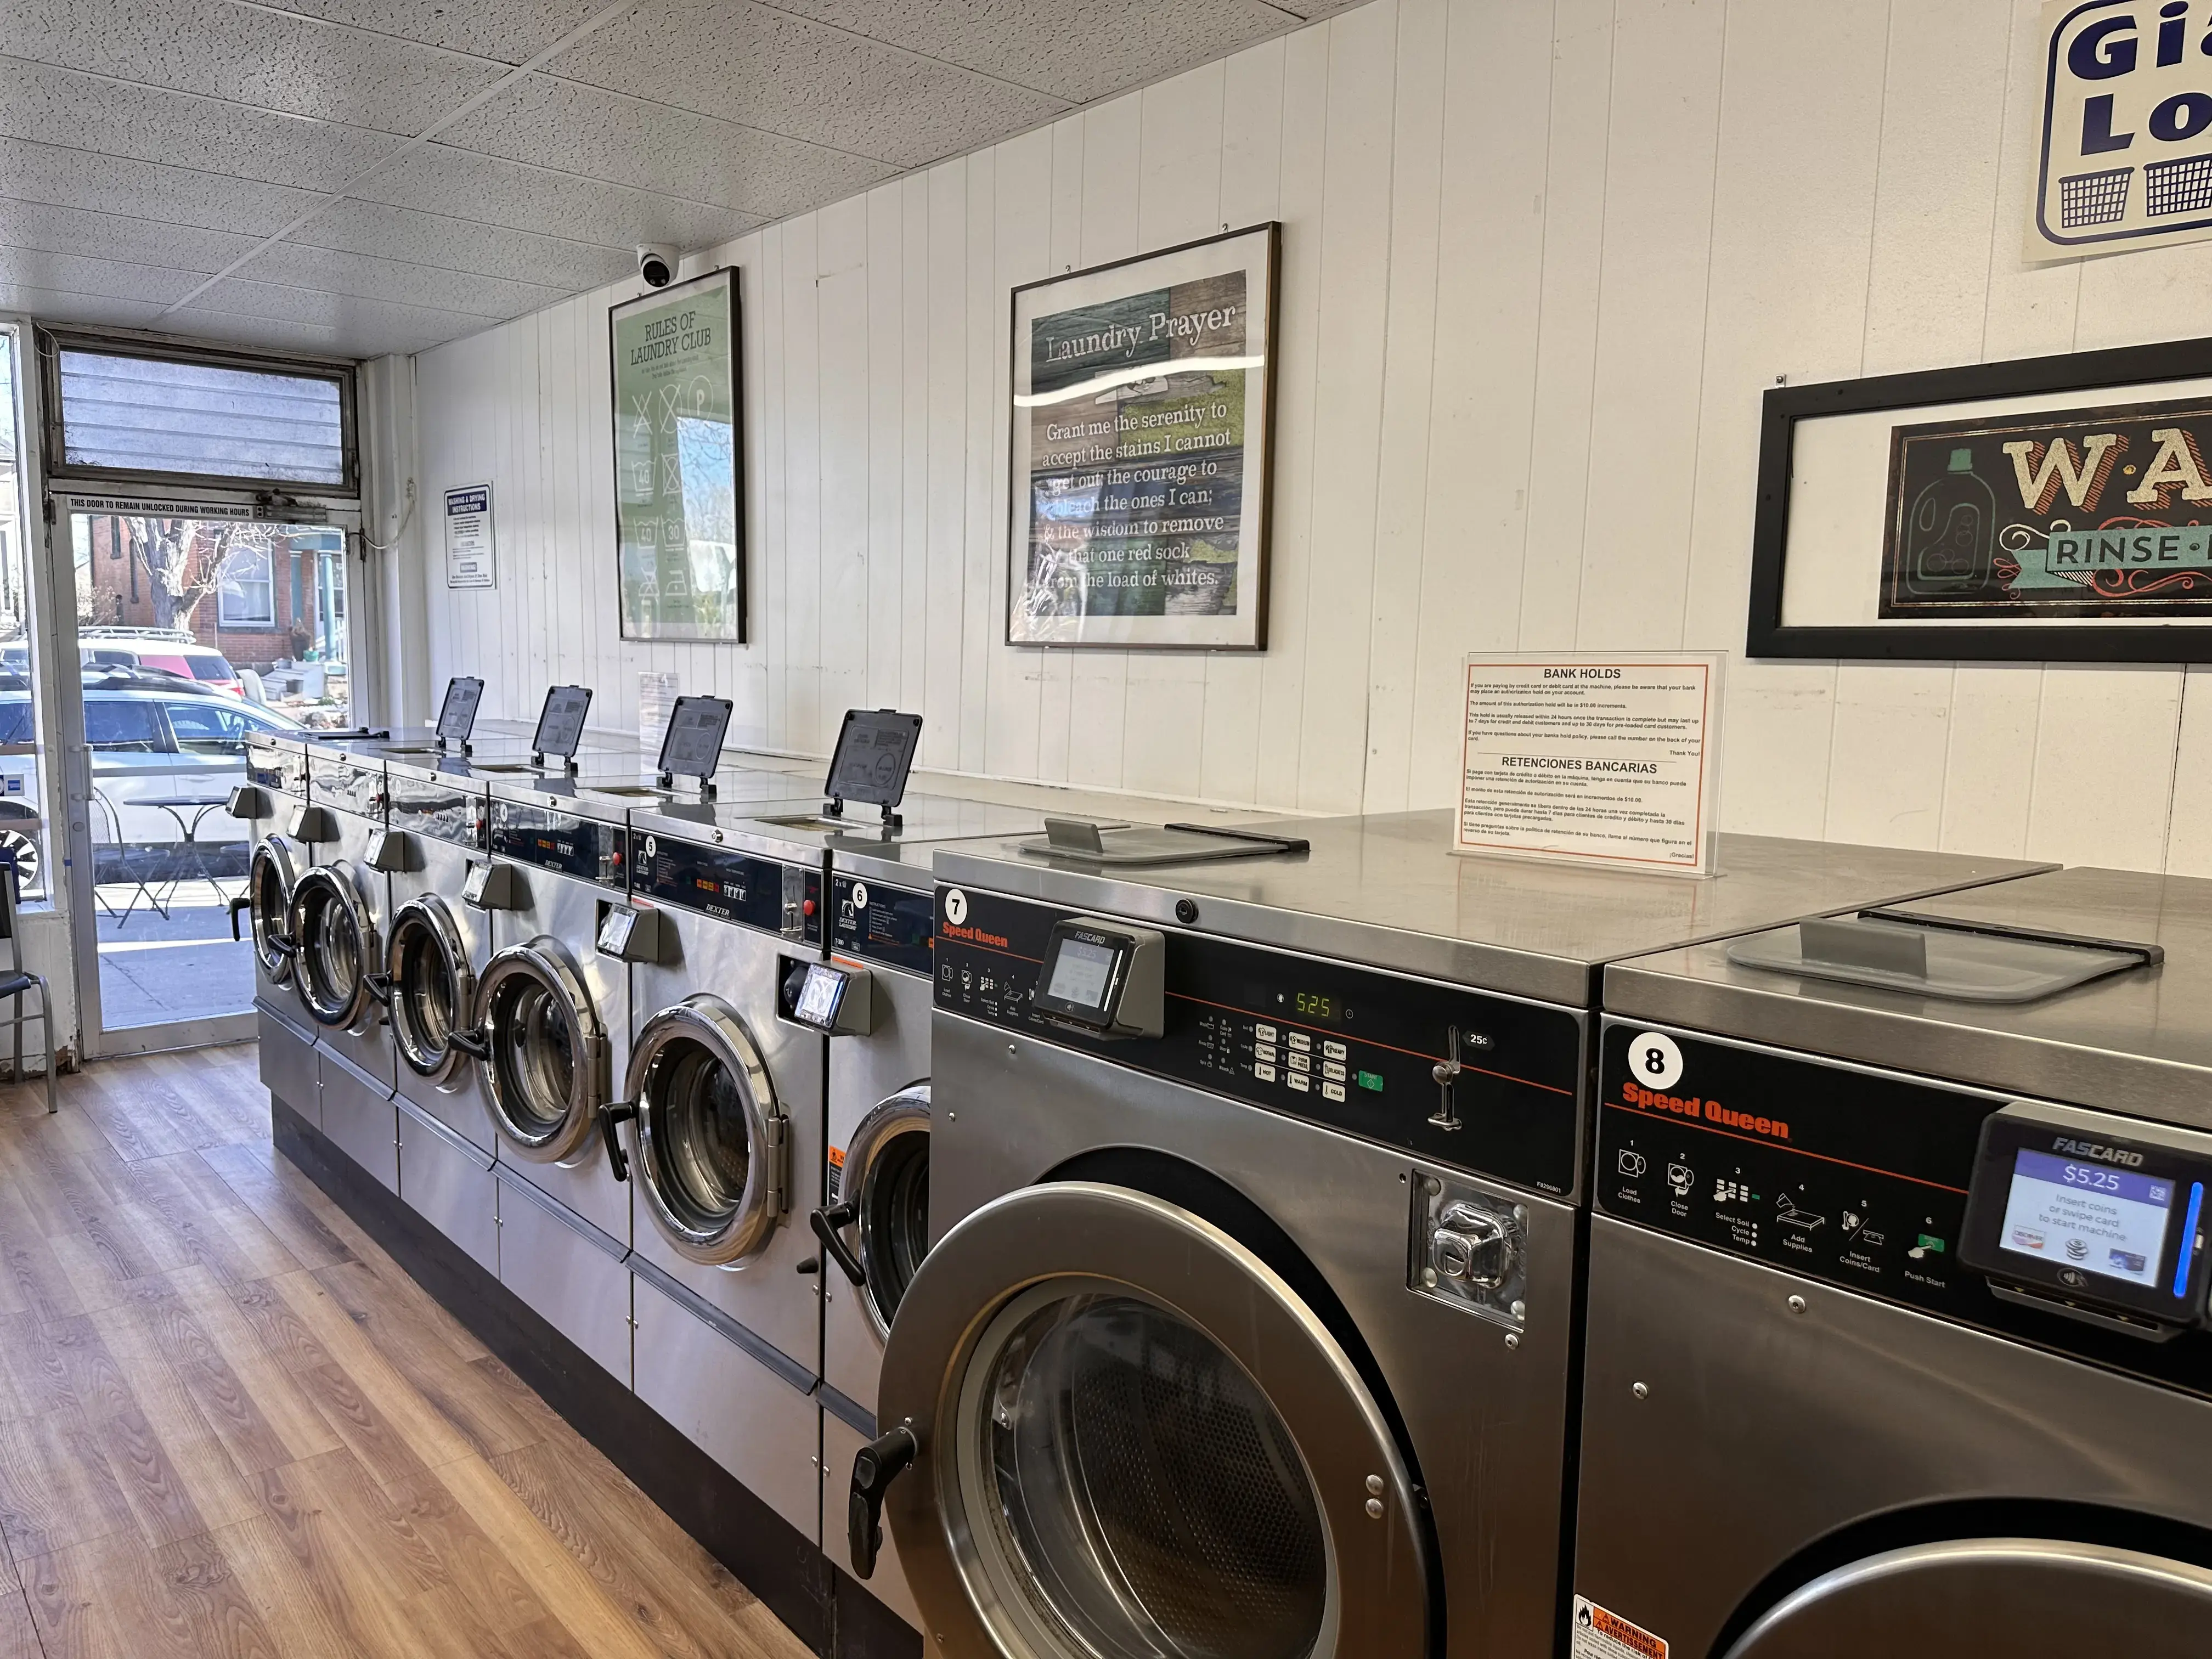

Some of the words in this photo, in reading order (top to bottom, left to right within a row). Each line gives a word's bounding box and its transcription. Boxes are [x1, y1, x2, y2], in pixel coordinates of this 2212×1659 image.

[645, 316, 677, 342] RULES
[680, 311, 696, 330] OF
[1046, 324, 1141, 362] Laundry
[1149, 306, 1235, 346] Prayer
[631, 336, 679, 365] LAUNDRY
[681, 328, 711, 351] CLUB
[697, 389, 705, 415] P
[1047, 423, 1085, 441] Grant
[1088, 421, 1110, 435] me
[1114, 415, 1138, 432] the
[1142, 404, 1206, 429] serenity
[1211, 402, 1227, 419] to
[1042, 449, 1086, 470] accept
[1090, 445, 1113, 461] the
[1116, 438, 1161, 459] stains
[1165, 435, 1171, 453] I
[1176, 428, 1231, 452] cannot
[639, 470, 650, 484] 40
[1053, 474, 1074, 496] get
[1108, 468, 1130, 485] the
[1134, 464, 1197, 486] courage
[1201, 459, 1217, 476] to
[71, 498, 85, 507] THIS
[87, 500, 104, 508] DOOR
[115, 501, 140, 510] REMAIN
[142, 503, 174, 512] UNLOCKED
[176, 505, 199, 514] DURING
[200, 506, 228, 515] WORKING
[229, 508, 250, 516] HOURS
[448, 495, 465, 505] WASHING
[470, 493, 485, 501] DRYING
[1056, 496, 1100, 516] bleach
[1105, 495, 1127, 510] the
[1132, 493, 1165, 508] ones
[1169, 488, 1176, 505] I
[1180, 488, 1213, 505] can;
[452, 503, 481, 514] INSTRUCTIONS
[641, 528, 652, 541] 40
[668, 526, 679, 540] 30
[1058, 524, 1079, 539] the
[1084, 519, 1138, 537] wisdom
[1143, 520, 1158, 534] to
[1162, 516, 1224, 533] remove
[1069, 548, 1095, 563] that
[1098, 549, 1125, 562] one
[1128, 545, 1152, 561] red
[1156, 542, 1189, 560] sock
[1108, 571, 1138, 587] load
[1142, 569, 1158, 586] of
[1161, 569, 1218, 585] whites.
[1544, 668, 1577, 679] BANK
[1580, 668, 1621, 679] HOLDS
[1502, 757, 1582, 770] RETENCIONES
[1585, 761, 1657, 774] BANCARIAS
[649, 842, 653, 851] 5
[545, 860, 562, 869] DEXTER
[857, 890, 862, 901] 6
[706, 904, 730, 916] DEXTER
[952, 899, 960, 915] 7
[839, 917, 856, 926] DEXTER
[943, 921, 973, 939] Speed
[975, 928, 1008, 947] Queen
[1074, 931, 1106, 944] FASCARD
[1296, 1038, 1310, 1046] MEDIUM
[1471, 1034, 1487, 1044] 25¢
[1645, 1048, 1664, 1074] 8
[1329, 1067, 1344, 1076] DELICATES
[1623, 1082, 1700, 1117] Speed
[1705, 1101, 1788, 1138] Queen
[2052, 1137, 2143, 1166] FASCARD
[2063, 1164, 2120, 1190] $5.25
[1618, 1192, 1640, 1203] Clothes
[1622, 1186, 1637, 1195] Load
[1671, 1201, 1688, 1210] Close
[1672, 1208, 1686, 1216] Door
[2056, 1194, 2085, 1207] Insert
[2088, 1203, 2117, 1215] coins
[1716, 1212, 1735, 1223] Select
[1737, 1218, 1749, 1227] Soil
[2062, 1208, 2093, 1222] swipe
[2095, 1215, 2119, 1228] card
[1731, 1226, 1749, 1235] Cycle
[2039, 1214, 2050, 1223] to
[2053, 1218, 2076, 1230] start
[2078, 1223, 2126, 1242] machine
[1733, 1234, 1750, 1244] Temp
[1783, 1239, 1812, 1252] Supplies
[1791, 1234, 1804, 1243] Add
[1840, 1256, 1880, 1273] Coins/Card
[1850, 1251, 1870, 1262] Insert
[1905, 1271, 1924, 1282] Push
[1926, 1277, 1945, 1288] Start
[1611, 1617, 1656, 1648] WARNING
[1604, 1633, 1621, 1646] reduce
[1631, 1647, 1641, 1657] risk
[1605, 1625, 1663, 1659] AVERTISSEMENT
